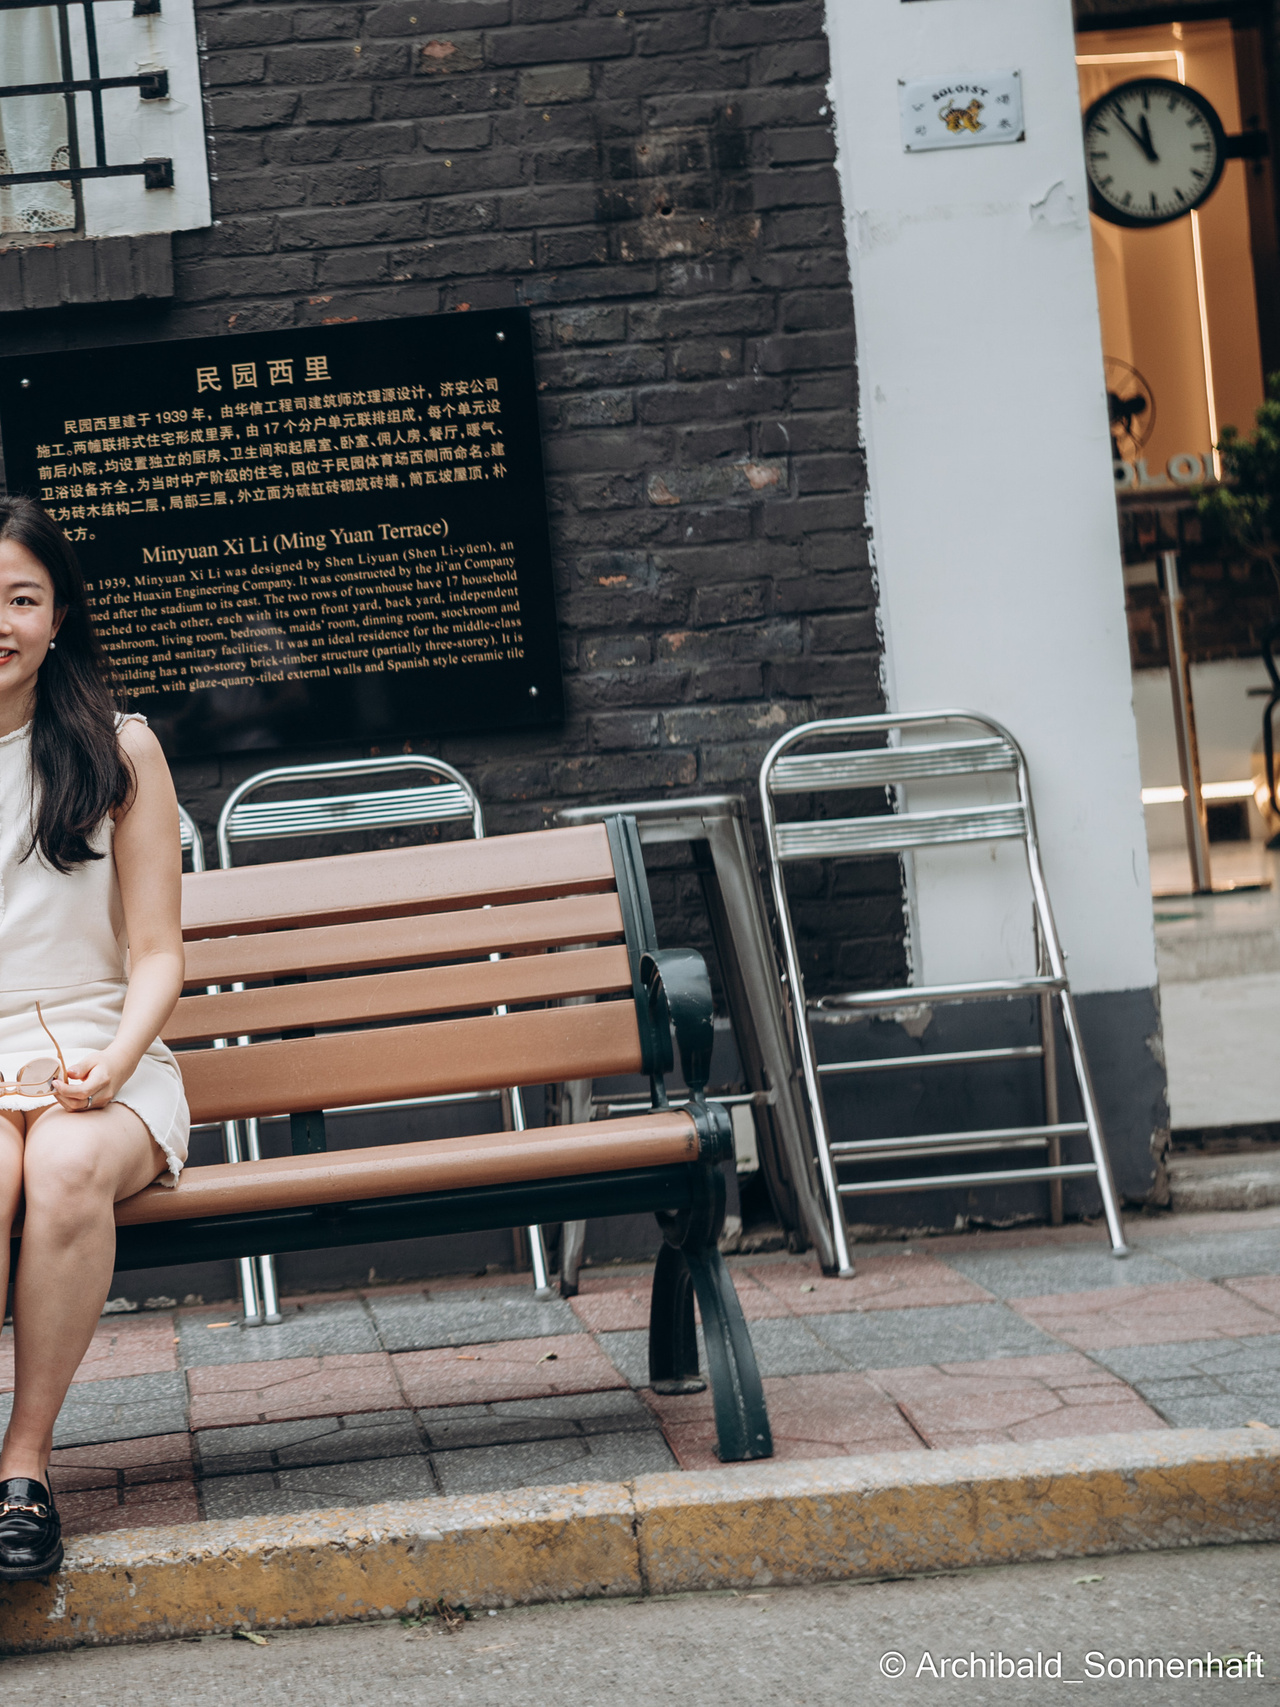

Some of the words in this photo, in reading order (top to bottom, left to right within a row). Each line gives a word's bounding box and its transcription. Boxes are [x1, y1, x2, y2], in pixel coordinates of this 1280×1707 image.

[931, 84, 990, 102] SOLOIST
[196, 355, 332, 393] 民园西里
[98, 577, 130, 590] 1939,
[134, 573, 186, 586] Minyuan
[189, 569, 204, 581] Xi
[207, 567, 221, 579] Li
[224, 567, 247, 577] was
[250, 559, 303, 575] designed
[305, 558, 320, 571] by
[324, 556, 354, 568] Shen
[357, 552, 399, 566] Liyuan
[402, 547, 437, 562] (Shen
[500, 541, 514, 551] an
[141, 544, 219, 565] Minyuan
[222, 537, 245, 556] Xi
[248, 535, 269, 553] Li
[272, 531, 327, 555] (Ming
[329, 527, 374, 545] Yuan
[377, 517, 449, 540] Terrace)
[98, 593, 112, 605] of
[113, 592, 130, 604] the
[132, 588, 172, 602] Huaxin
[174, 582, 240, 599] Engineering
[241, 579, 296, 592] Company.
[299, 574, 308, 586] It
[310, 575, 332, 584] was
[333, 565, 396, 582] constructed
[398, 565, 412, 578] by
[415, 562, 432, 574] the
[463, 557, 515, 570] Company
[112, 607, 138, 619] after
[140, 605, 158, 617] the
[160, 602, 203, 615] stadium
[205, 601, 217, 610] to
[219, 598, 234, 609] its
[235, 597, 261, 608] east.
[263, 593, 285, 605] The
[287, 592, 308, 602] two
[310, 590, 338, 600] rows
[340, 585, 353, 597] of
[354, 582, 413, 596] townhouse
[415, 578, 442, 590] have
[446, 575, 458, 587] 17
[461, 569, 518, 586] household
[92, 622, 132, 636] tached
[135, 623, 147, 633] to
[150, 618, 177, 631] each
[179, 616, 213, 628] other,
[216, 612, 243, 625] each
[245, 609, 271, 622] with
[275, 608, 290, 619] its
[292, 607, 317, 618] own
[320, 603, 348, 615] front
[352, 598, 382, 614] yard,
[384, 595, 412, 608] back
[415, 592, 445, 608] yard,
[448, 586, 518, 602] independent
[100, 638, 159, 651] washroom,
[161, 633, 194, 645] living
[195, 632, 228, 642] room,
[229, 626, 286, 639] bedrooms,
[327, 618, 360, 629] room,
[362, 612, 404, 626] dinning
[406, 611, 438, 622] room,
[441, 605, 498, 618] stockroom
[500, 599, 520, 613] and
[108, 653, 149, 666] heating
[151, 649, 172, 662] and
[174, 647, 217, 660] sanitary
[220, 641, 272, 656] facilities.
[275, 639, 284, 650] It
[287, 639, 309, 649] was
[311, 637, 325, 647] an
[327, 631, 355, 645] ideal
[357, 628, 410, 642] residence
[412, 625, 429, 637] for
[431, 623, 449, 635] the
[452, 617, 522, 633] middle-class
[110, 668, 157, 682] building
[158, 666, 178, 677] has
[180, 666, 187, 675] a
[189, 661, 246, 674] two-storey
[250, 652, 318, 668] brick-timber
[321, 648, 369, 661] structure
[371, 641, 422, 659] (partially
[425, 634, 498, 651] three-storey).
[501, 632, 510, 644] It
[513, 631, 523, 642] is
[161, 679, 186, 692] with
[188, 669, 285, 693] glaze-quarry-tiled
[286, 665, 330, 680] external
[332, 662, 362, 675] walls
[364, 659, 385, 673] and
[386, 655, 430, 672] Spanish
[432, 653, 458, 668] style
[460, 649, 504, 663] ceramic
[506, 647, 524, 659] tile
